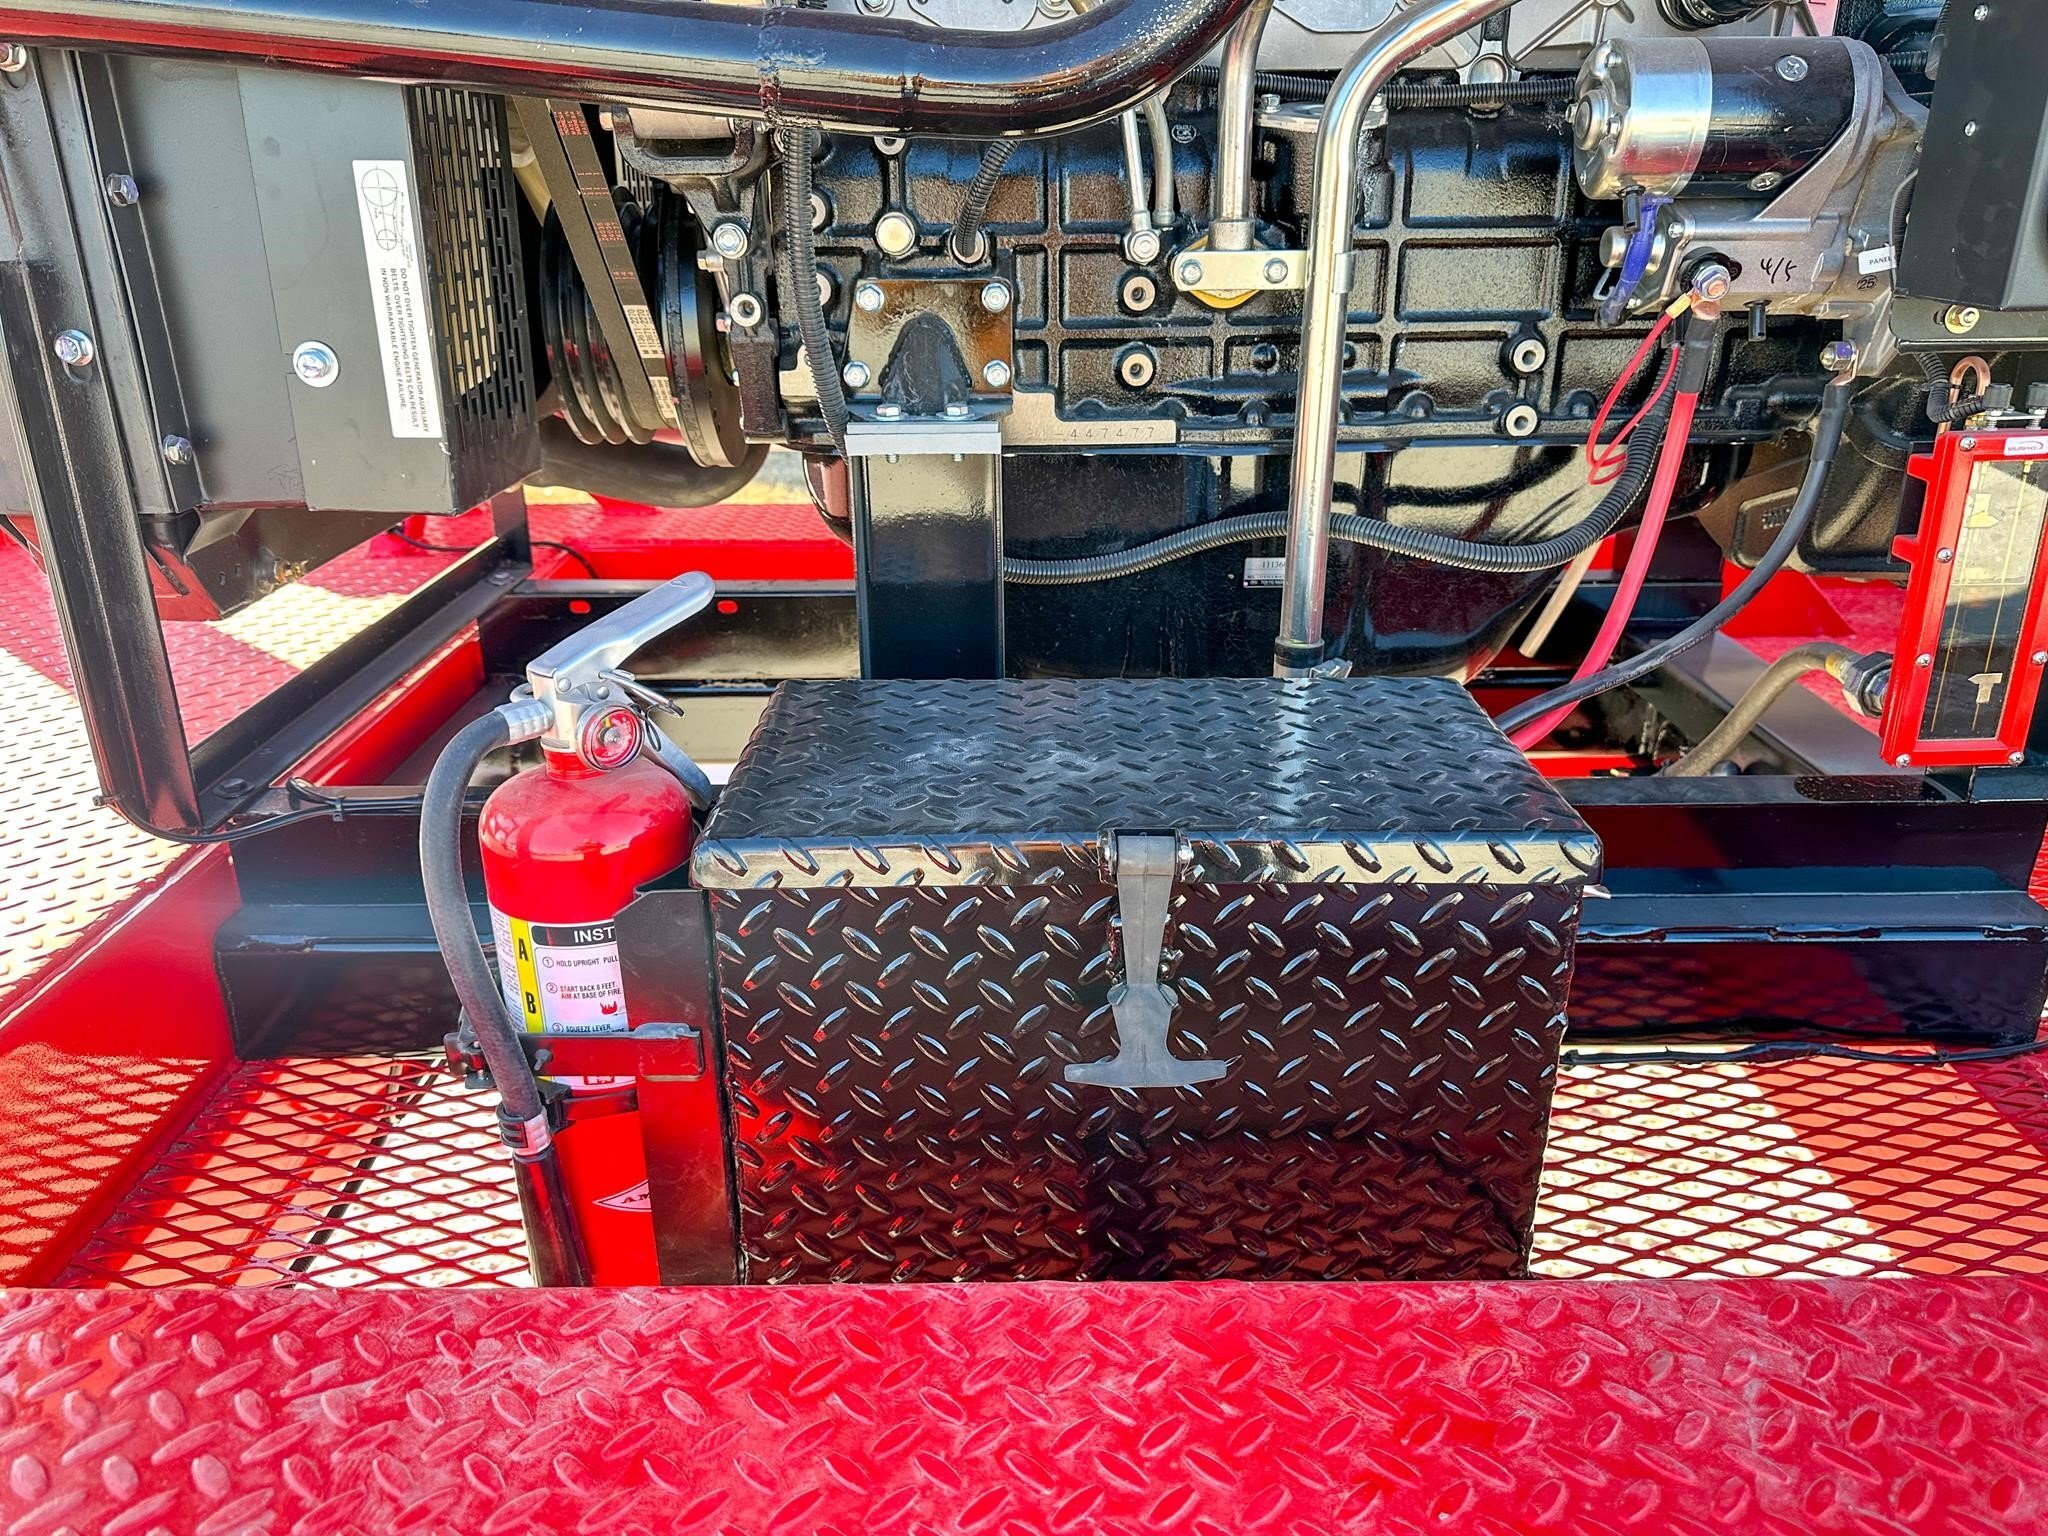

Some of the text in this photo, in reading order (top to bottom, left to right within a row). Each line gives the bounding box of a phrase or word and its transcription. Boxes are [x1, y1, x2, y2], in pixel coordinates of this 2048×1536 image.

[385, 295, 398, 348] WARRANTABLE
[393, 351, 401, 377] ENGINE
[400, 268, 407, 279] DO
[408, 320, 416, 350] TIGHTEN
[412, 352, 423, 394] GENERATOR
[419, 397, 429, 432] AUXILIARY
[398, 317, 409, 359] TIGHTENING
[404, 362, 412, 383] BELTS
[410, 402, 419, 428] RESULT
[574, 926, 615, 944] INST
[518, 938, 528, 962] A
[603, 955, 618, 964] PULL
[525, 992, 536, 1014] B
